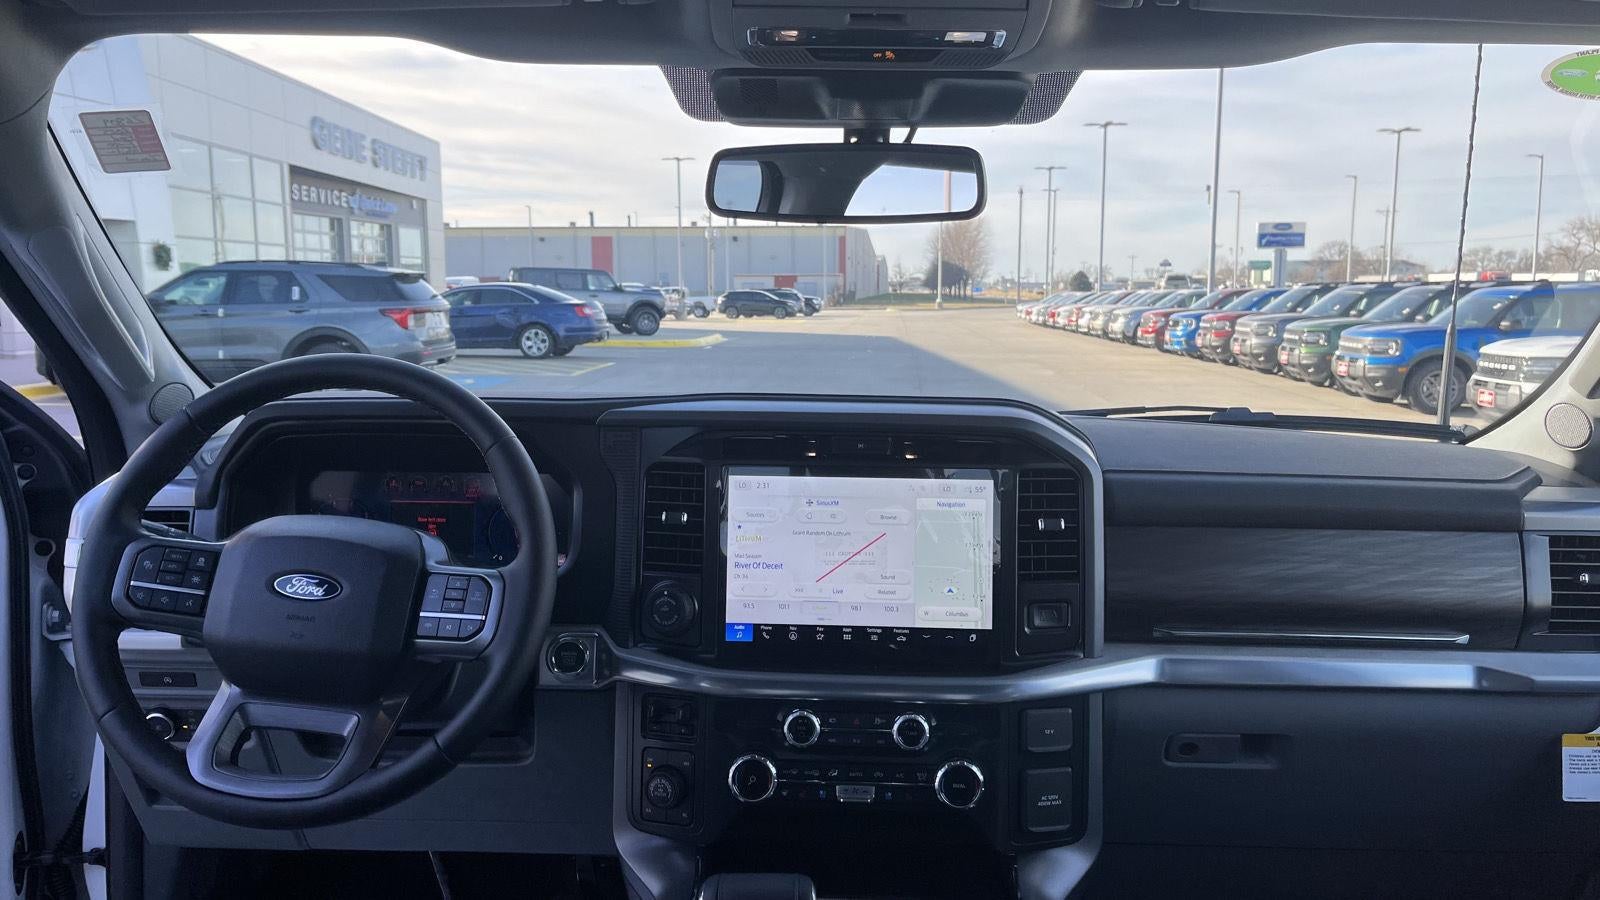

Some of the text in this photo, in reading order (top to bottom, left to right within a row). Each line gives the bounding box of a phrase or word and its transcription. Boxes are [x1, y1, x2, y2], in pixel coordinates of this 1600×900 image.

[310, 115, 428, 182] GENE STEFFY
[291, 183, 350, 209] SERVICE
[734, 561, 783, 570] River Of Deceit
[285, 575, 327, 597] Ford
